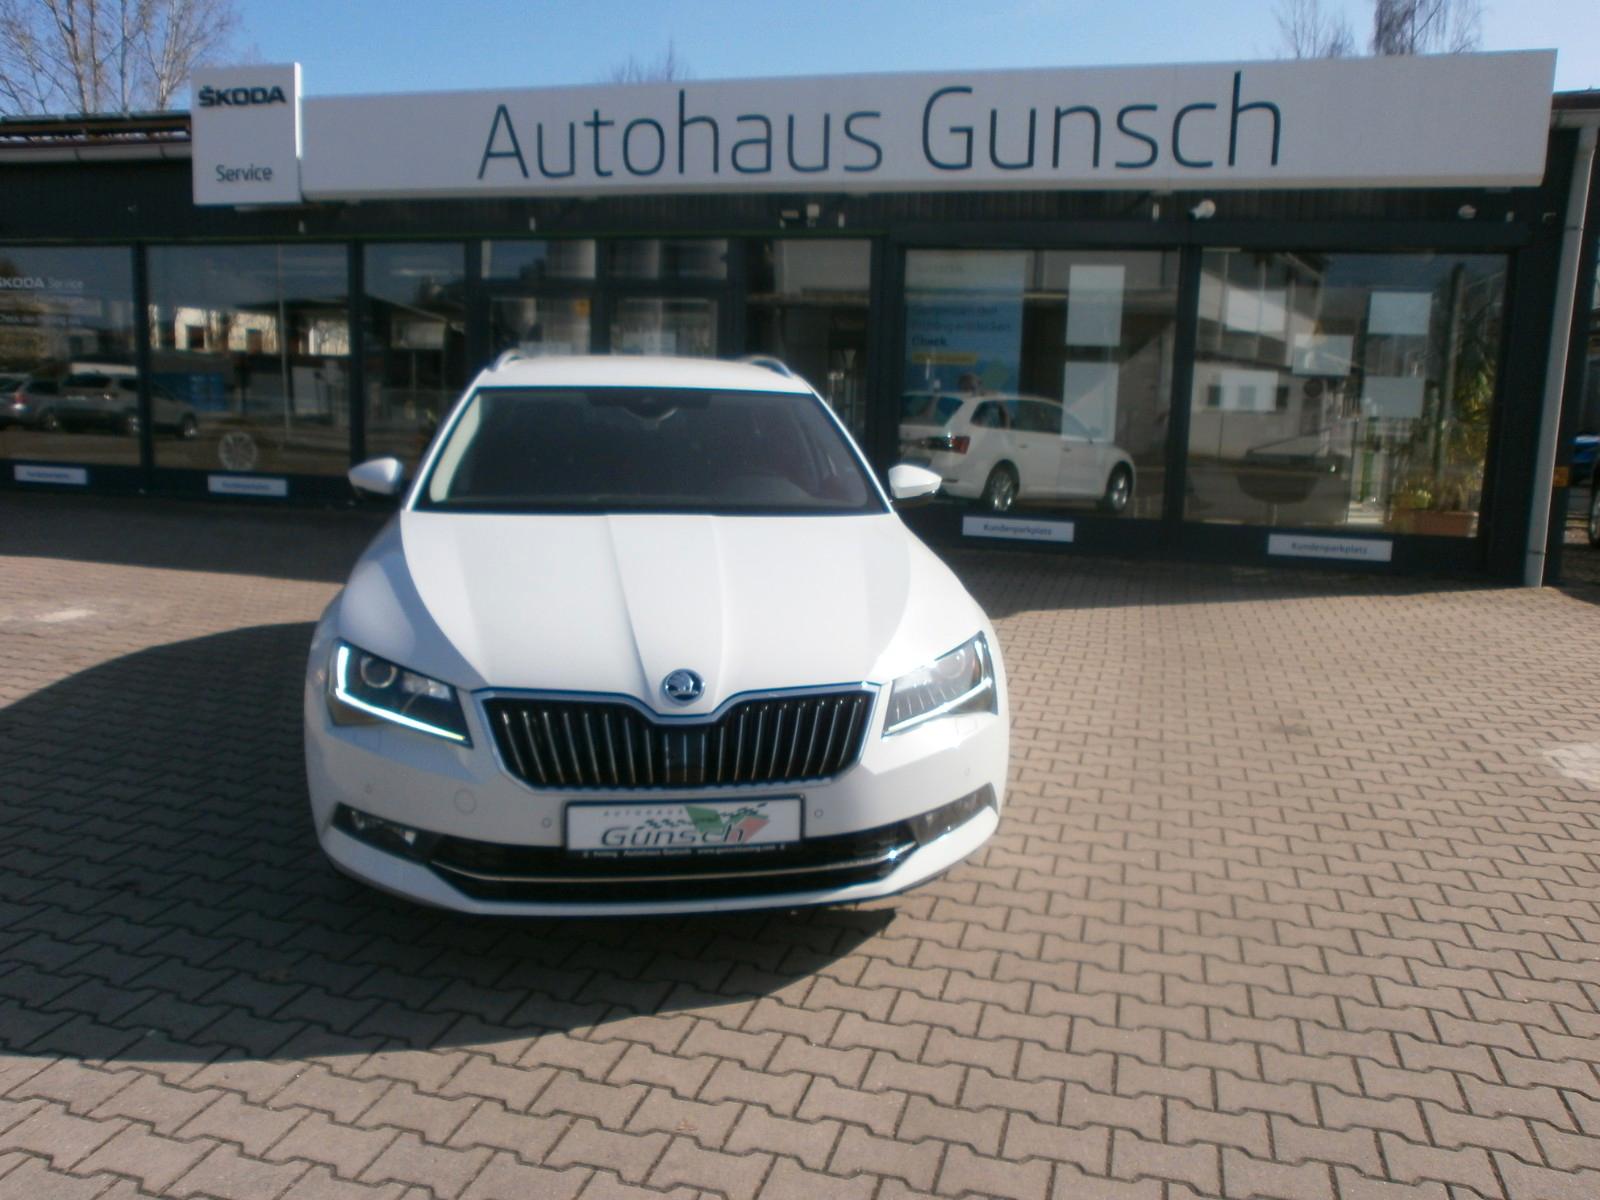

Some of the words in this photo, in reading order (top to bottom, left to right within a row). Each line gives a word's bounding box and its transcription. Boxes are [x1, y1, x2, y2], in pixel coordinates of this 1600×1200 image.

[198, 85, 287, 107] ŠKODA
[477, 89, 883, 180] Autohaus
[922, 70, 1281, 170] Gunsch
[215, 164, 273, 182] Service
